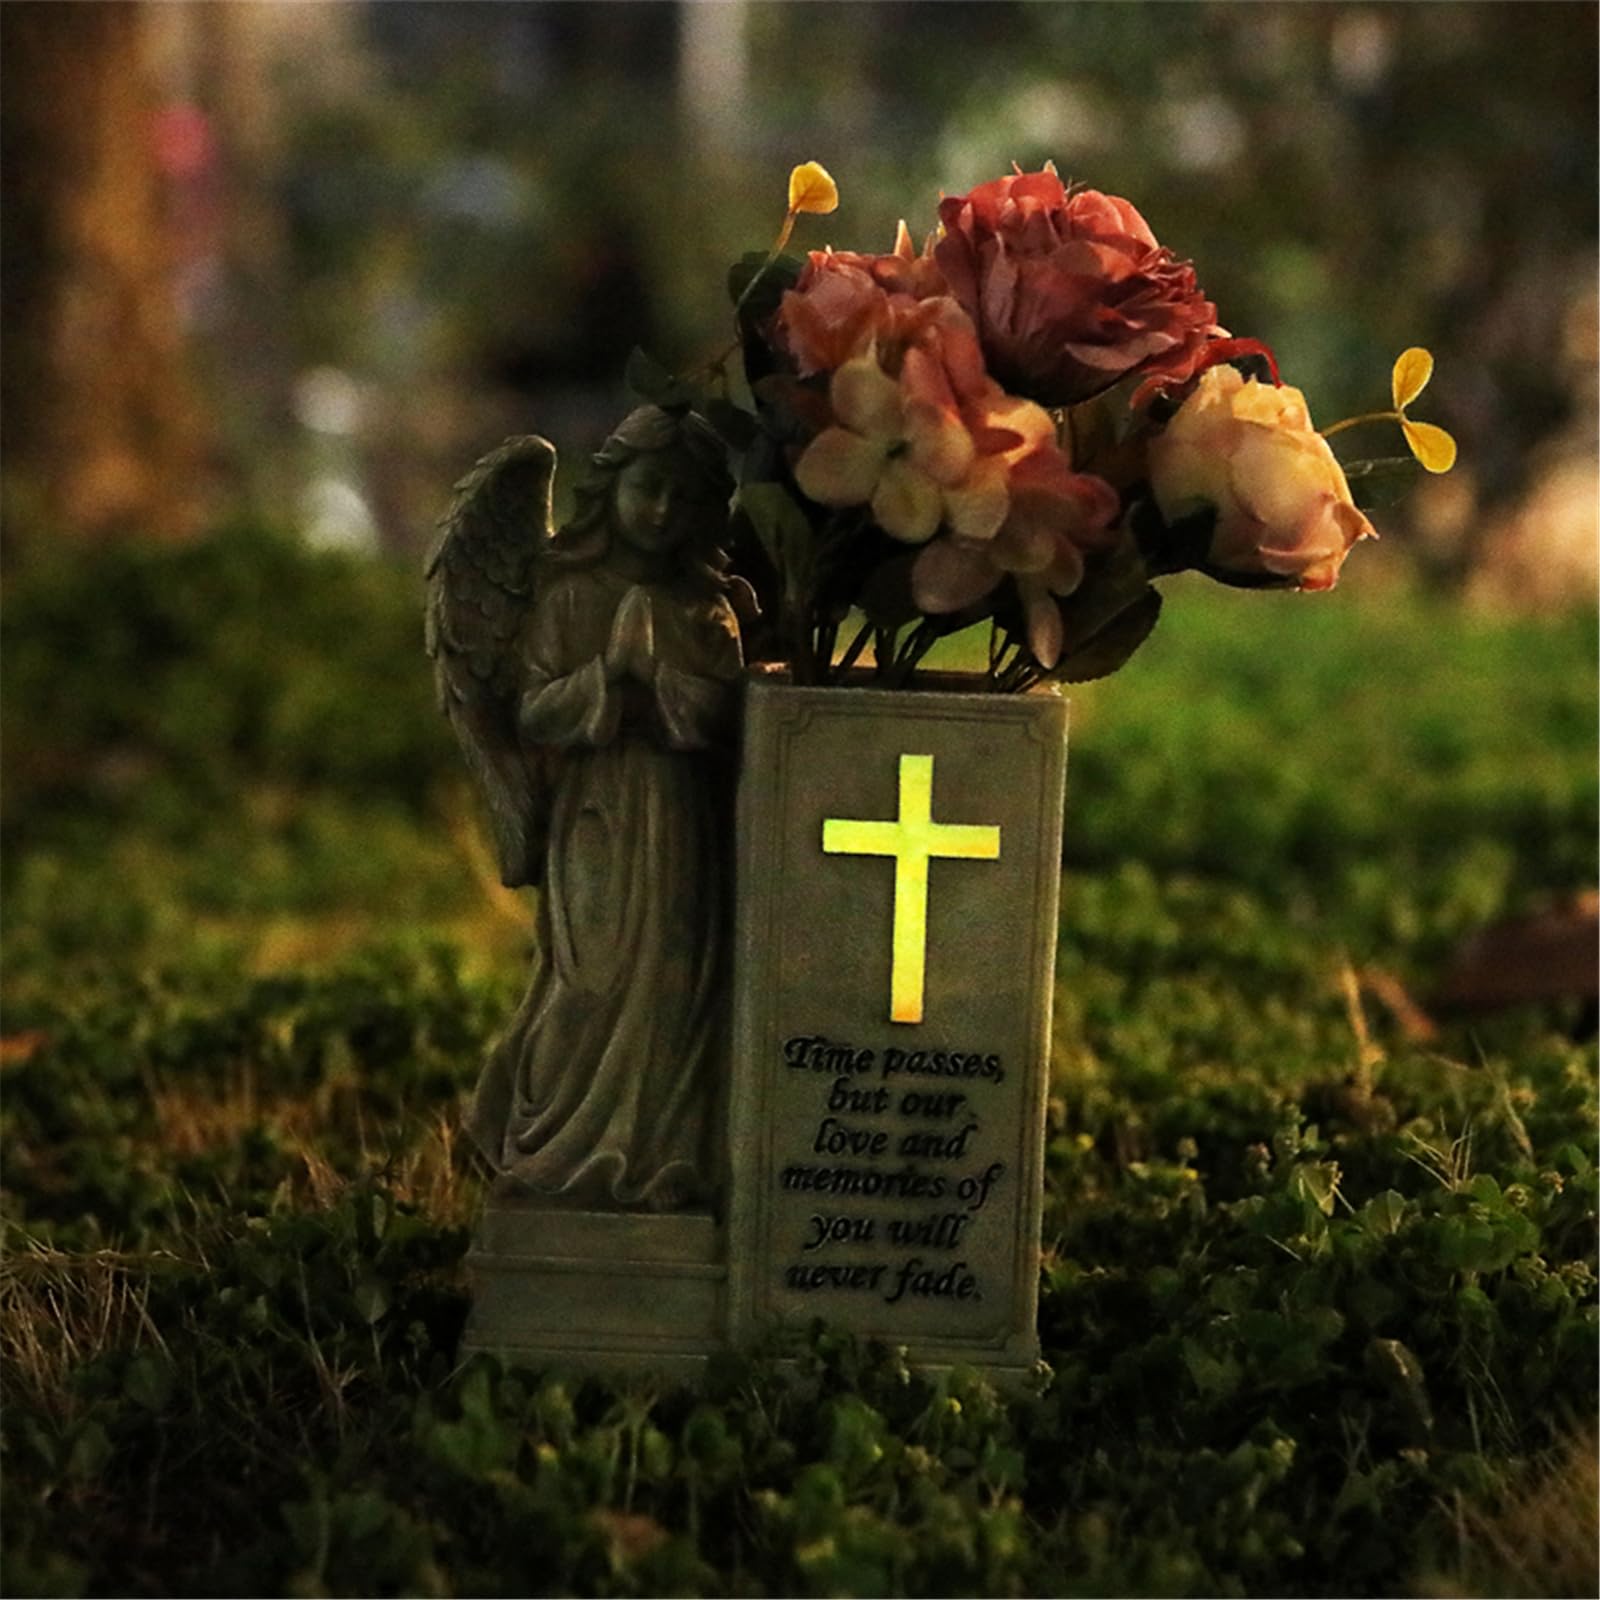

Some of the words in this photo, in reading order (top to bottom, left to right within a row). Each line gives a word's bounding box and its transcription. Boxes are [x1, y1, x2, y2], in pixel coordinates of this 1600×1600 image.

[784, 1036, 875, 1073] Time
[882, 1047, 1005, 1085] passes,
[828, 1076, 889, 1113] but
[814, 1118, 888, 1154] love
[902, 1124, 978, 1159] and
[780, 1165, 947, 1198] memories
[958, 1163, 1003, 1210] of
[804, 1214, 874, 1250] you
[888, 1213, 968, 1249] will
[884, 1258, 983, 1304] fade.
